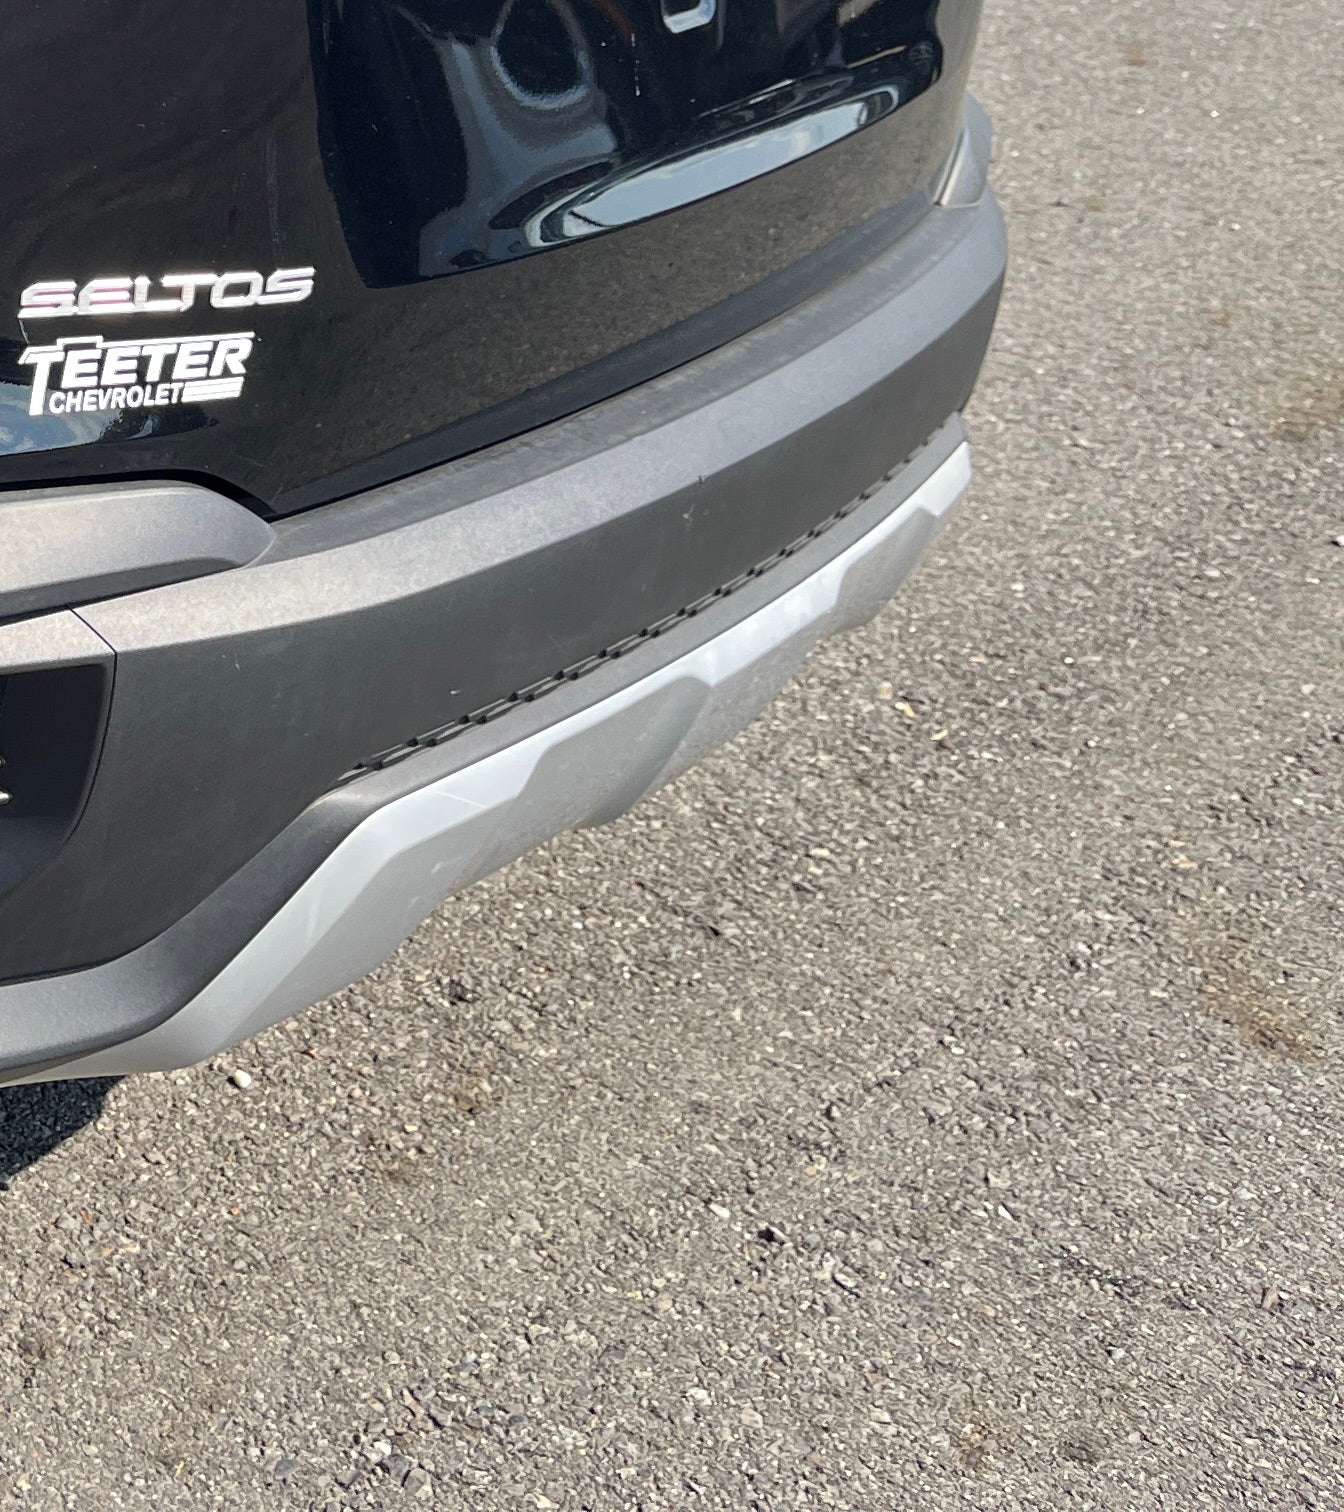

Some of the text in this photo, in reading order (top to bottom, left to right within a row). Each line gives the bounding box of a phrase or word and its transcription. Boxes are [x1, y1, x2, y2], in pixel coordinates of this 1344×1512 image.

[17, 267, 315, 319] SELTOS
[18, 331, 256, 416] TEETER
[48, 382, 184, 414] CHEVROLET
